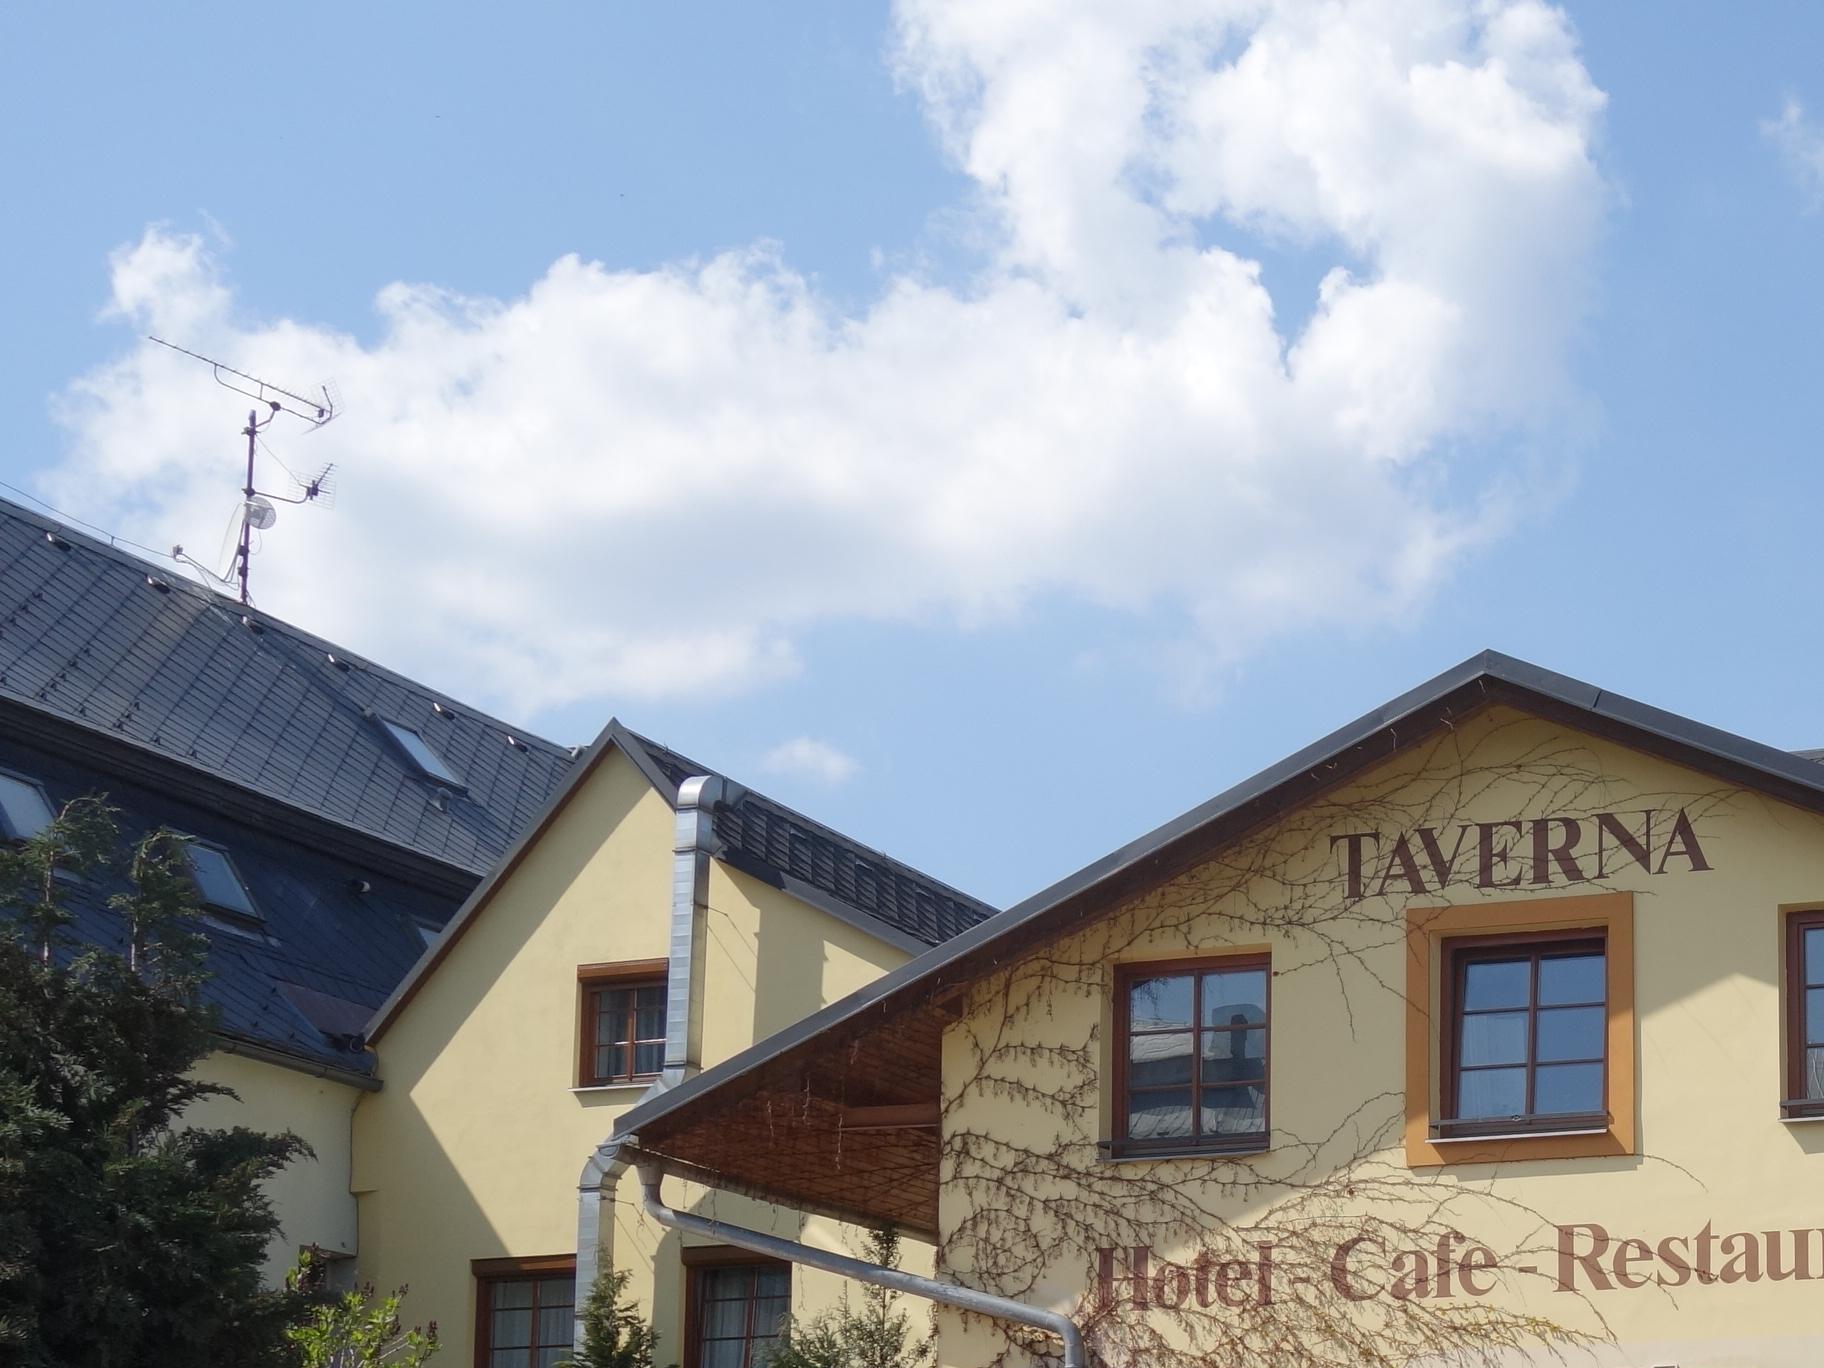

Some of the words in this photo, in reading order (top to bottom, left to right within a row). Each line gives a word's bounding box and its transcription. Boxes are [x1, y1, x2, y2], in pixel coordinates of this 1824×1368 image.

[1329, 807, 1714, 899] TAVERNA
[1099, 1240, 1275, 1312] Hotel
[1331, 1231, 1497, 1302] Cafe
